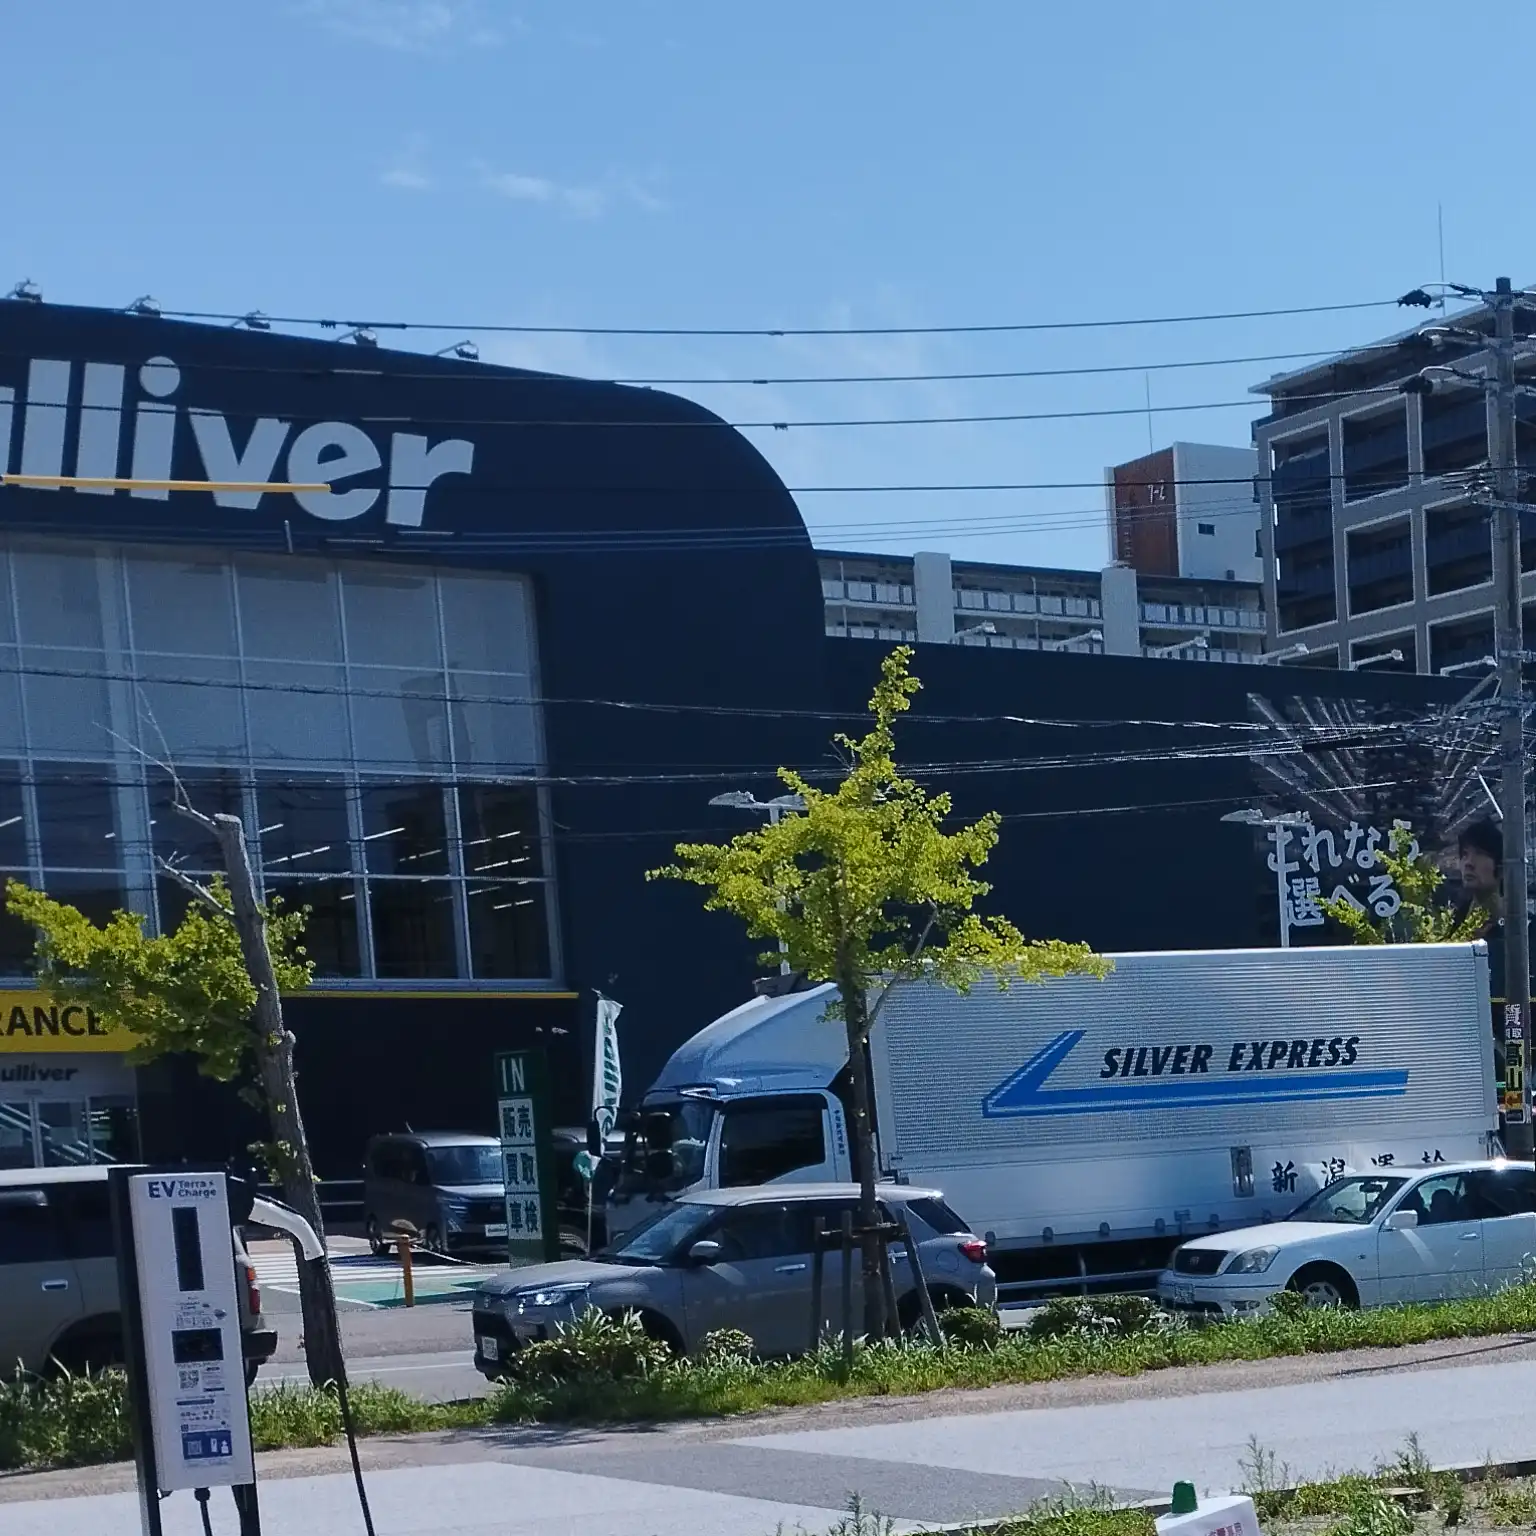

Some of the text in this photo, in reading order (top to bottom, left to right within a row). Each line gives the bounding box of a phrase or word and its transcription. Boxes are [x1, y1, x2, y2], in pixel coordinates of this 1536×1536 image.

[0, 356, 474, 527] lliver
[1285, 874, 1401, 927] 選べる
[0, 1006, 108, 1036] ANCE
[501, 1056, 526, 1093] IN
[1100, 1036, 1361, 1079] SILVER EXPRESS
[148, 1180, 176, 1199] EV
[178, 1188, 217, 1199] Charge
